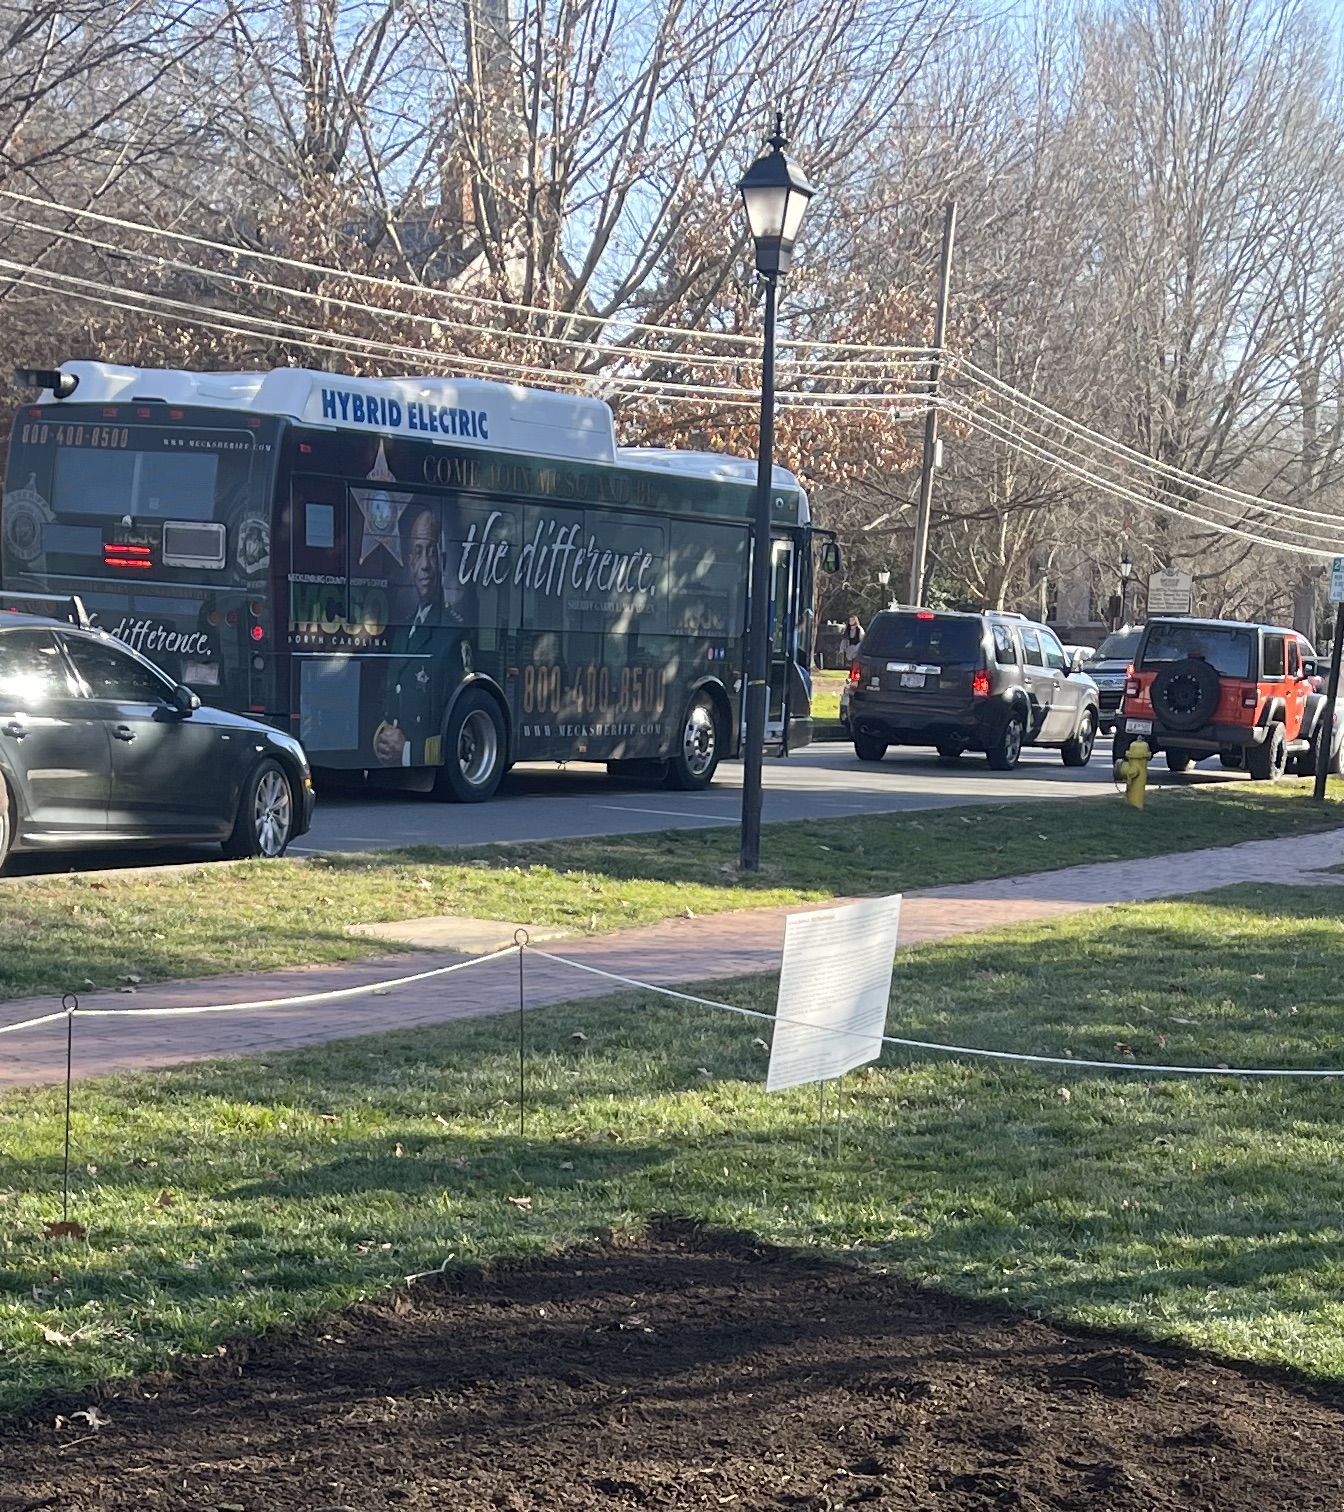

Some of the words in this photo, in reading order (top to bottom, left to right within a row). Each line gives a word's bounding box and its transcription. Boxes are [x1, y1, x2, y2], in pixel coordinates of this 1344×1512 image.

[321, 388, 402, 427] HYBRID
[407, 401, 489, 440] ELECTRIC
[21, 423, 129, 448] 800-400-8500
[423, 454, 480, 488] COME
[488, 462, 531, 493] JOIN
[459, 511, 509, 586] the
[514, 517, 656, 597] difference.
[1334, 560, 1340, 569] 2
[287, 635, 324, 645] NORTH
[332, 635, 388, 648] CAROLINA
[523, 664, 667, 714] 800-400-8500
